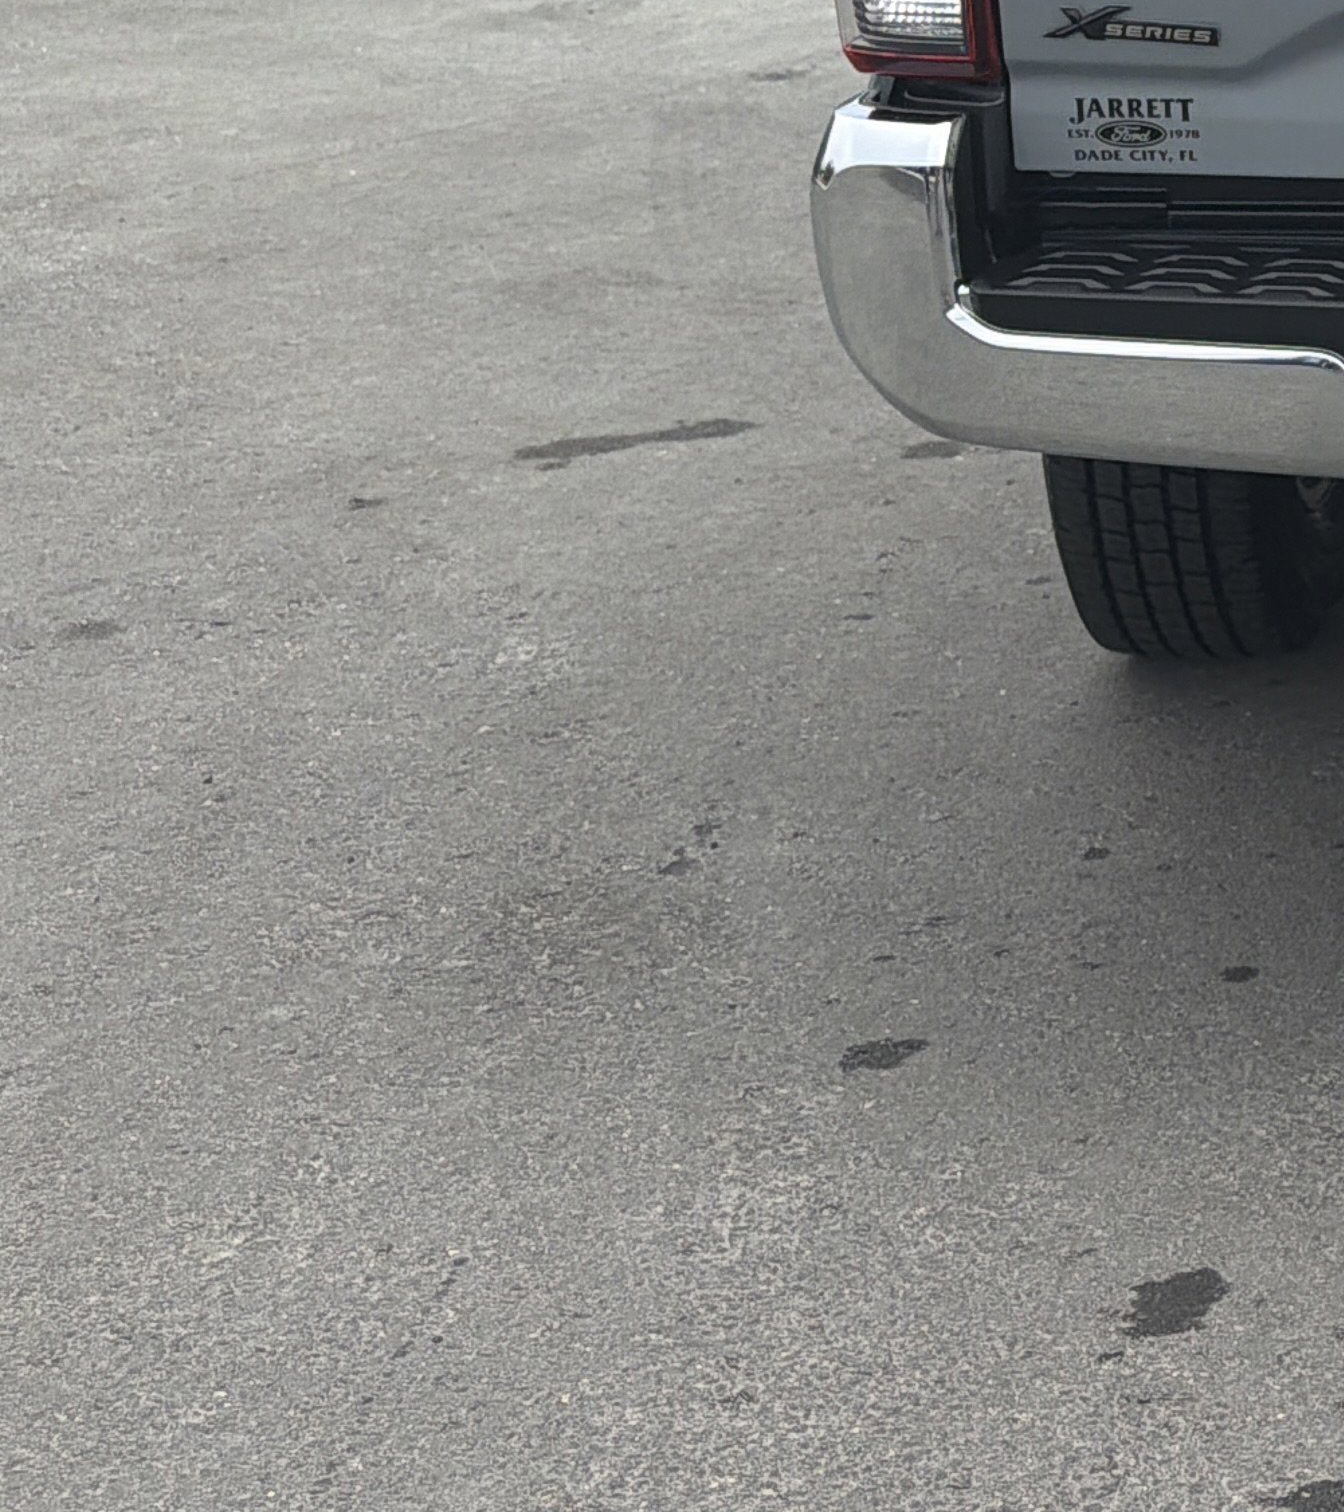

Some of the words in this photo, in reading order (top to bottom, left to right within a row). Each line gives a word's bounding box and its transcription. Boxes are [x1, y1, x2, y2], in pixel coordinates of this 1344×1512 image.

[1103, 23, 1212, 44] SERIES
[1069, 97, 1194, 125] JARRETT
[1067, 129, 1095, 139] EST.
[1111, 125, 1154, 144] Ford
[1169, 129, 1201, 139] 1978
[1074, 149, 1123, 162] DADE
[1129, 149, 1173, 163] CITY,
[1179, 150, 1198, 162] FL
